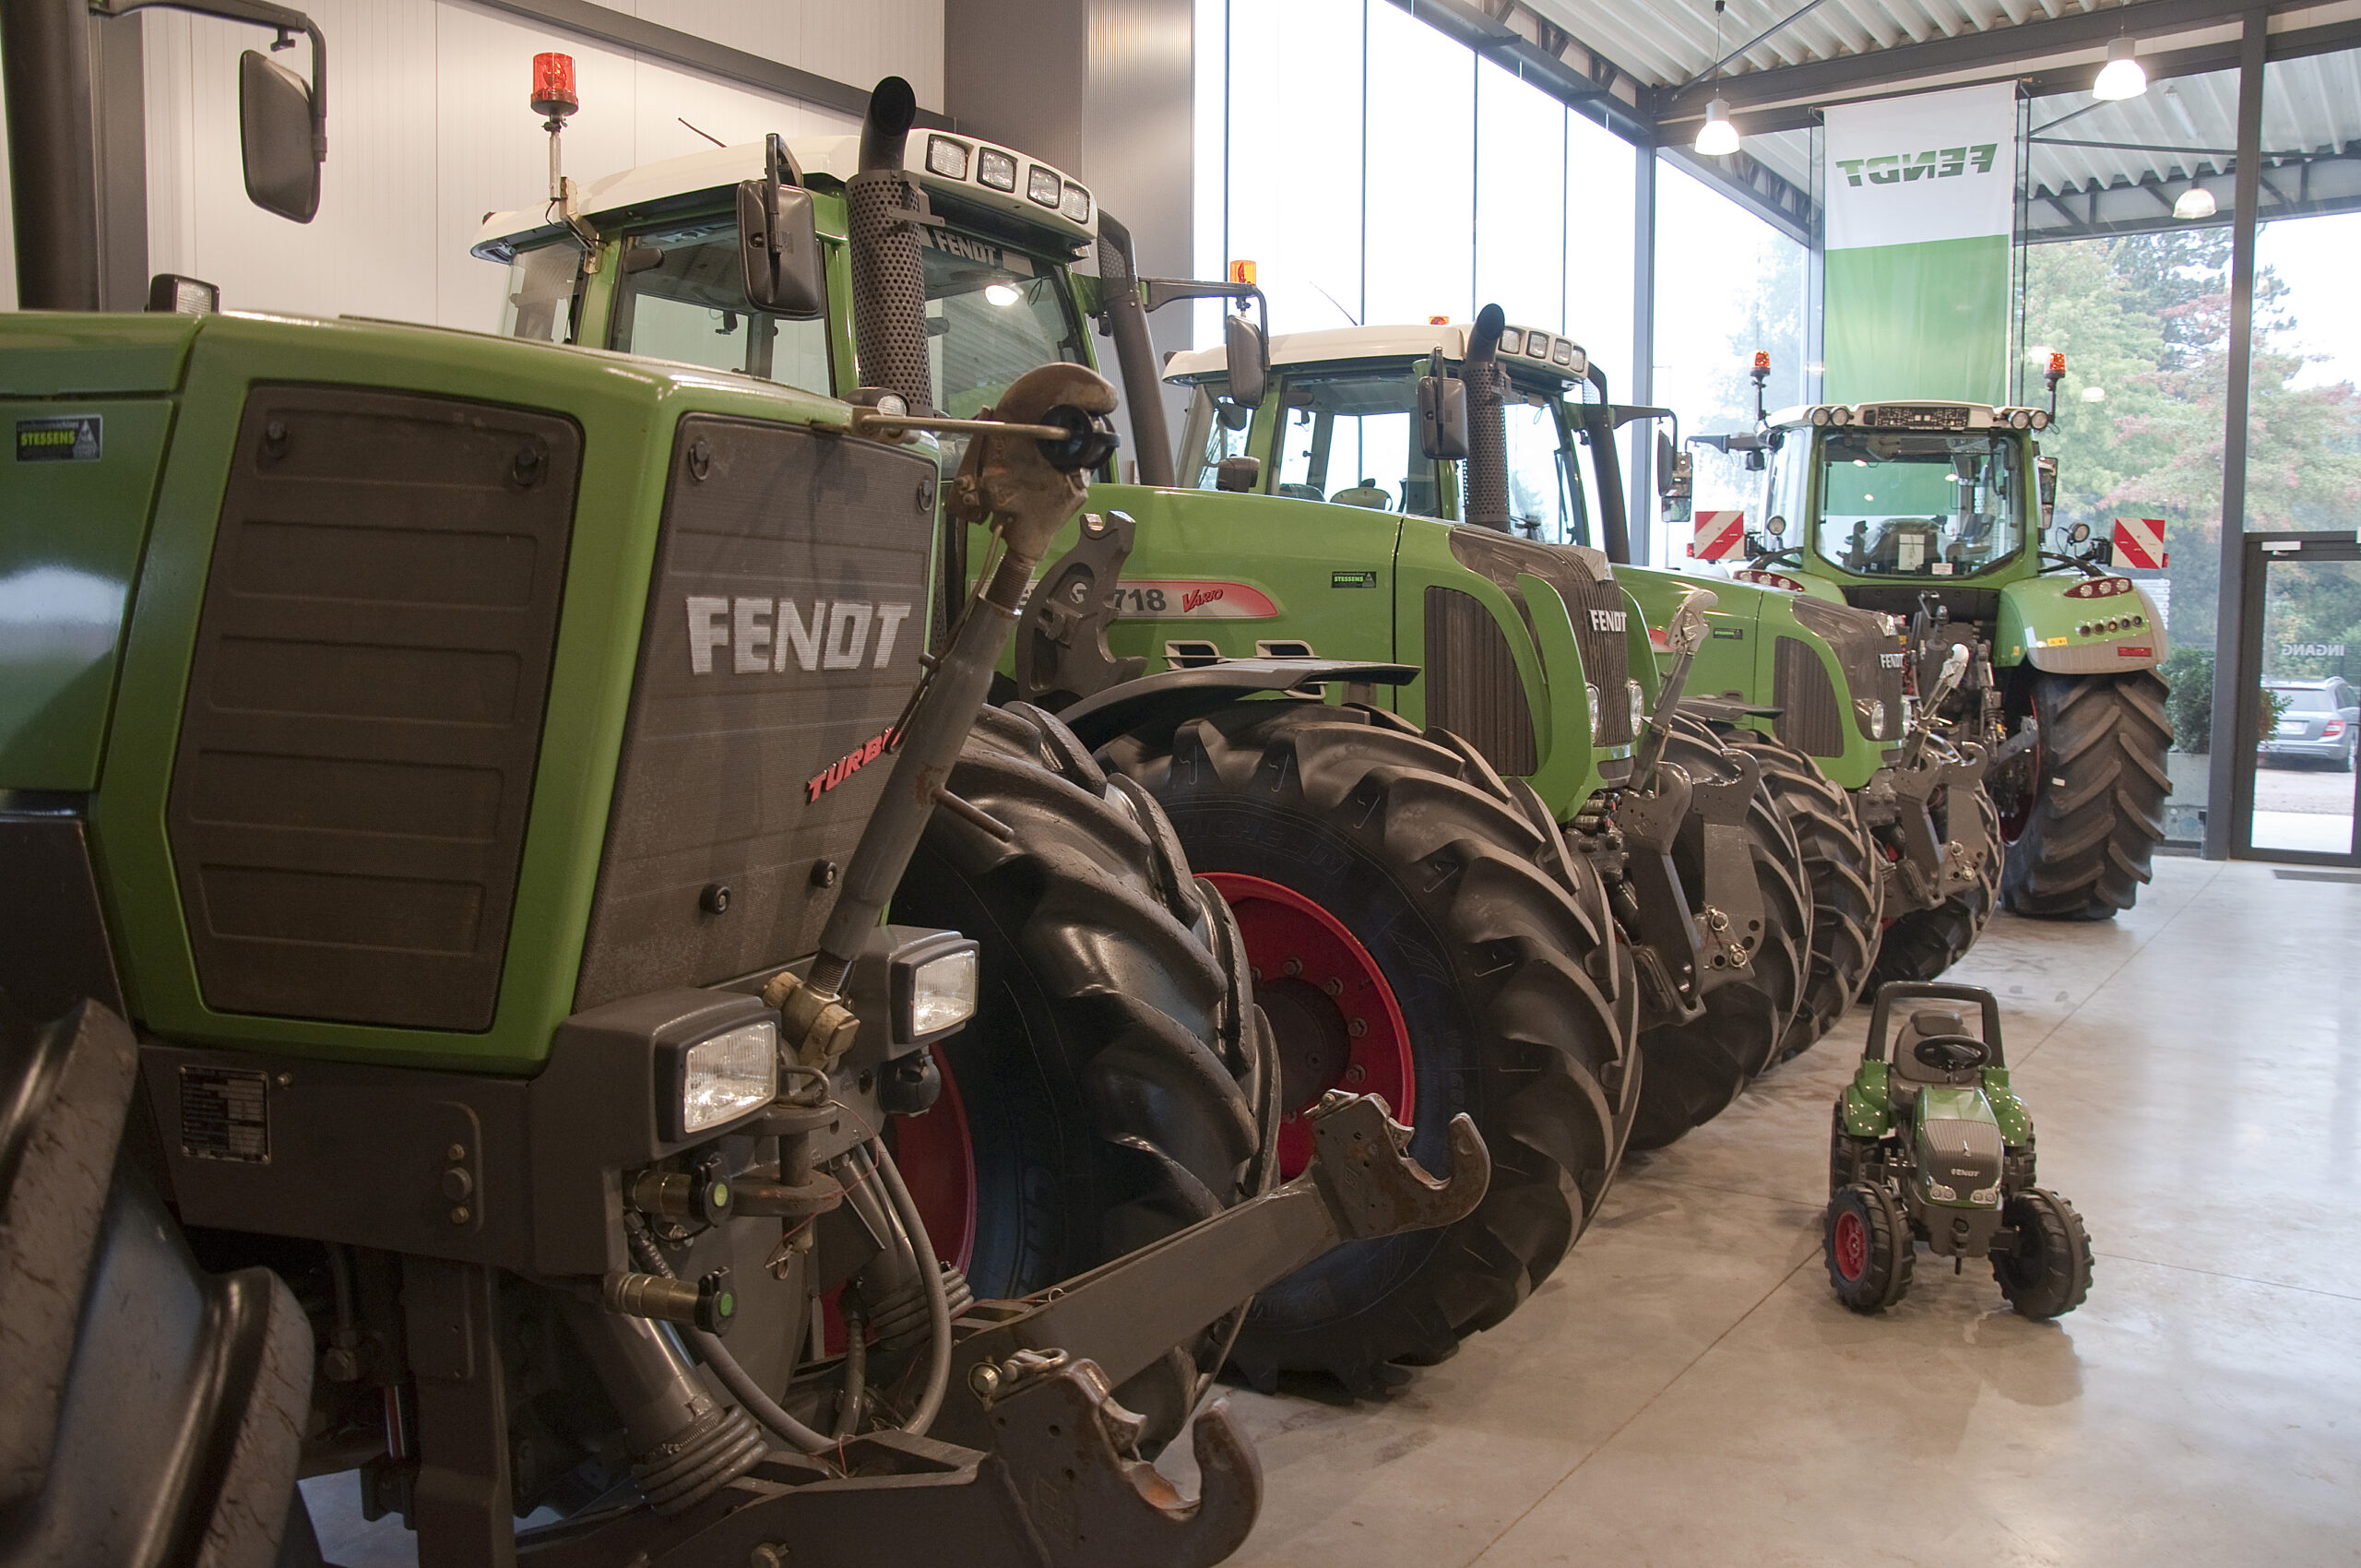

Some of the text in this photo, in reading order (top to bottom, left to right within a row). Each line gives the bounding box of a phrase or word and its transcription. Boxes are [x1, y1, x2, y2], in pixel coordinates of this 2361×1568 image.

[932, 229, 996, 267] FENDT
[21, 430, 76, 446] STESSENS
[1113, 588, 1167, 612] 718
[1588, 609, 1627, 632] FENDT
[686, 596, 912, 676] FENDT
